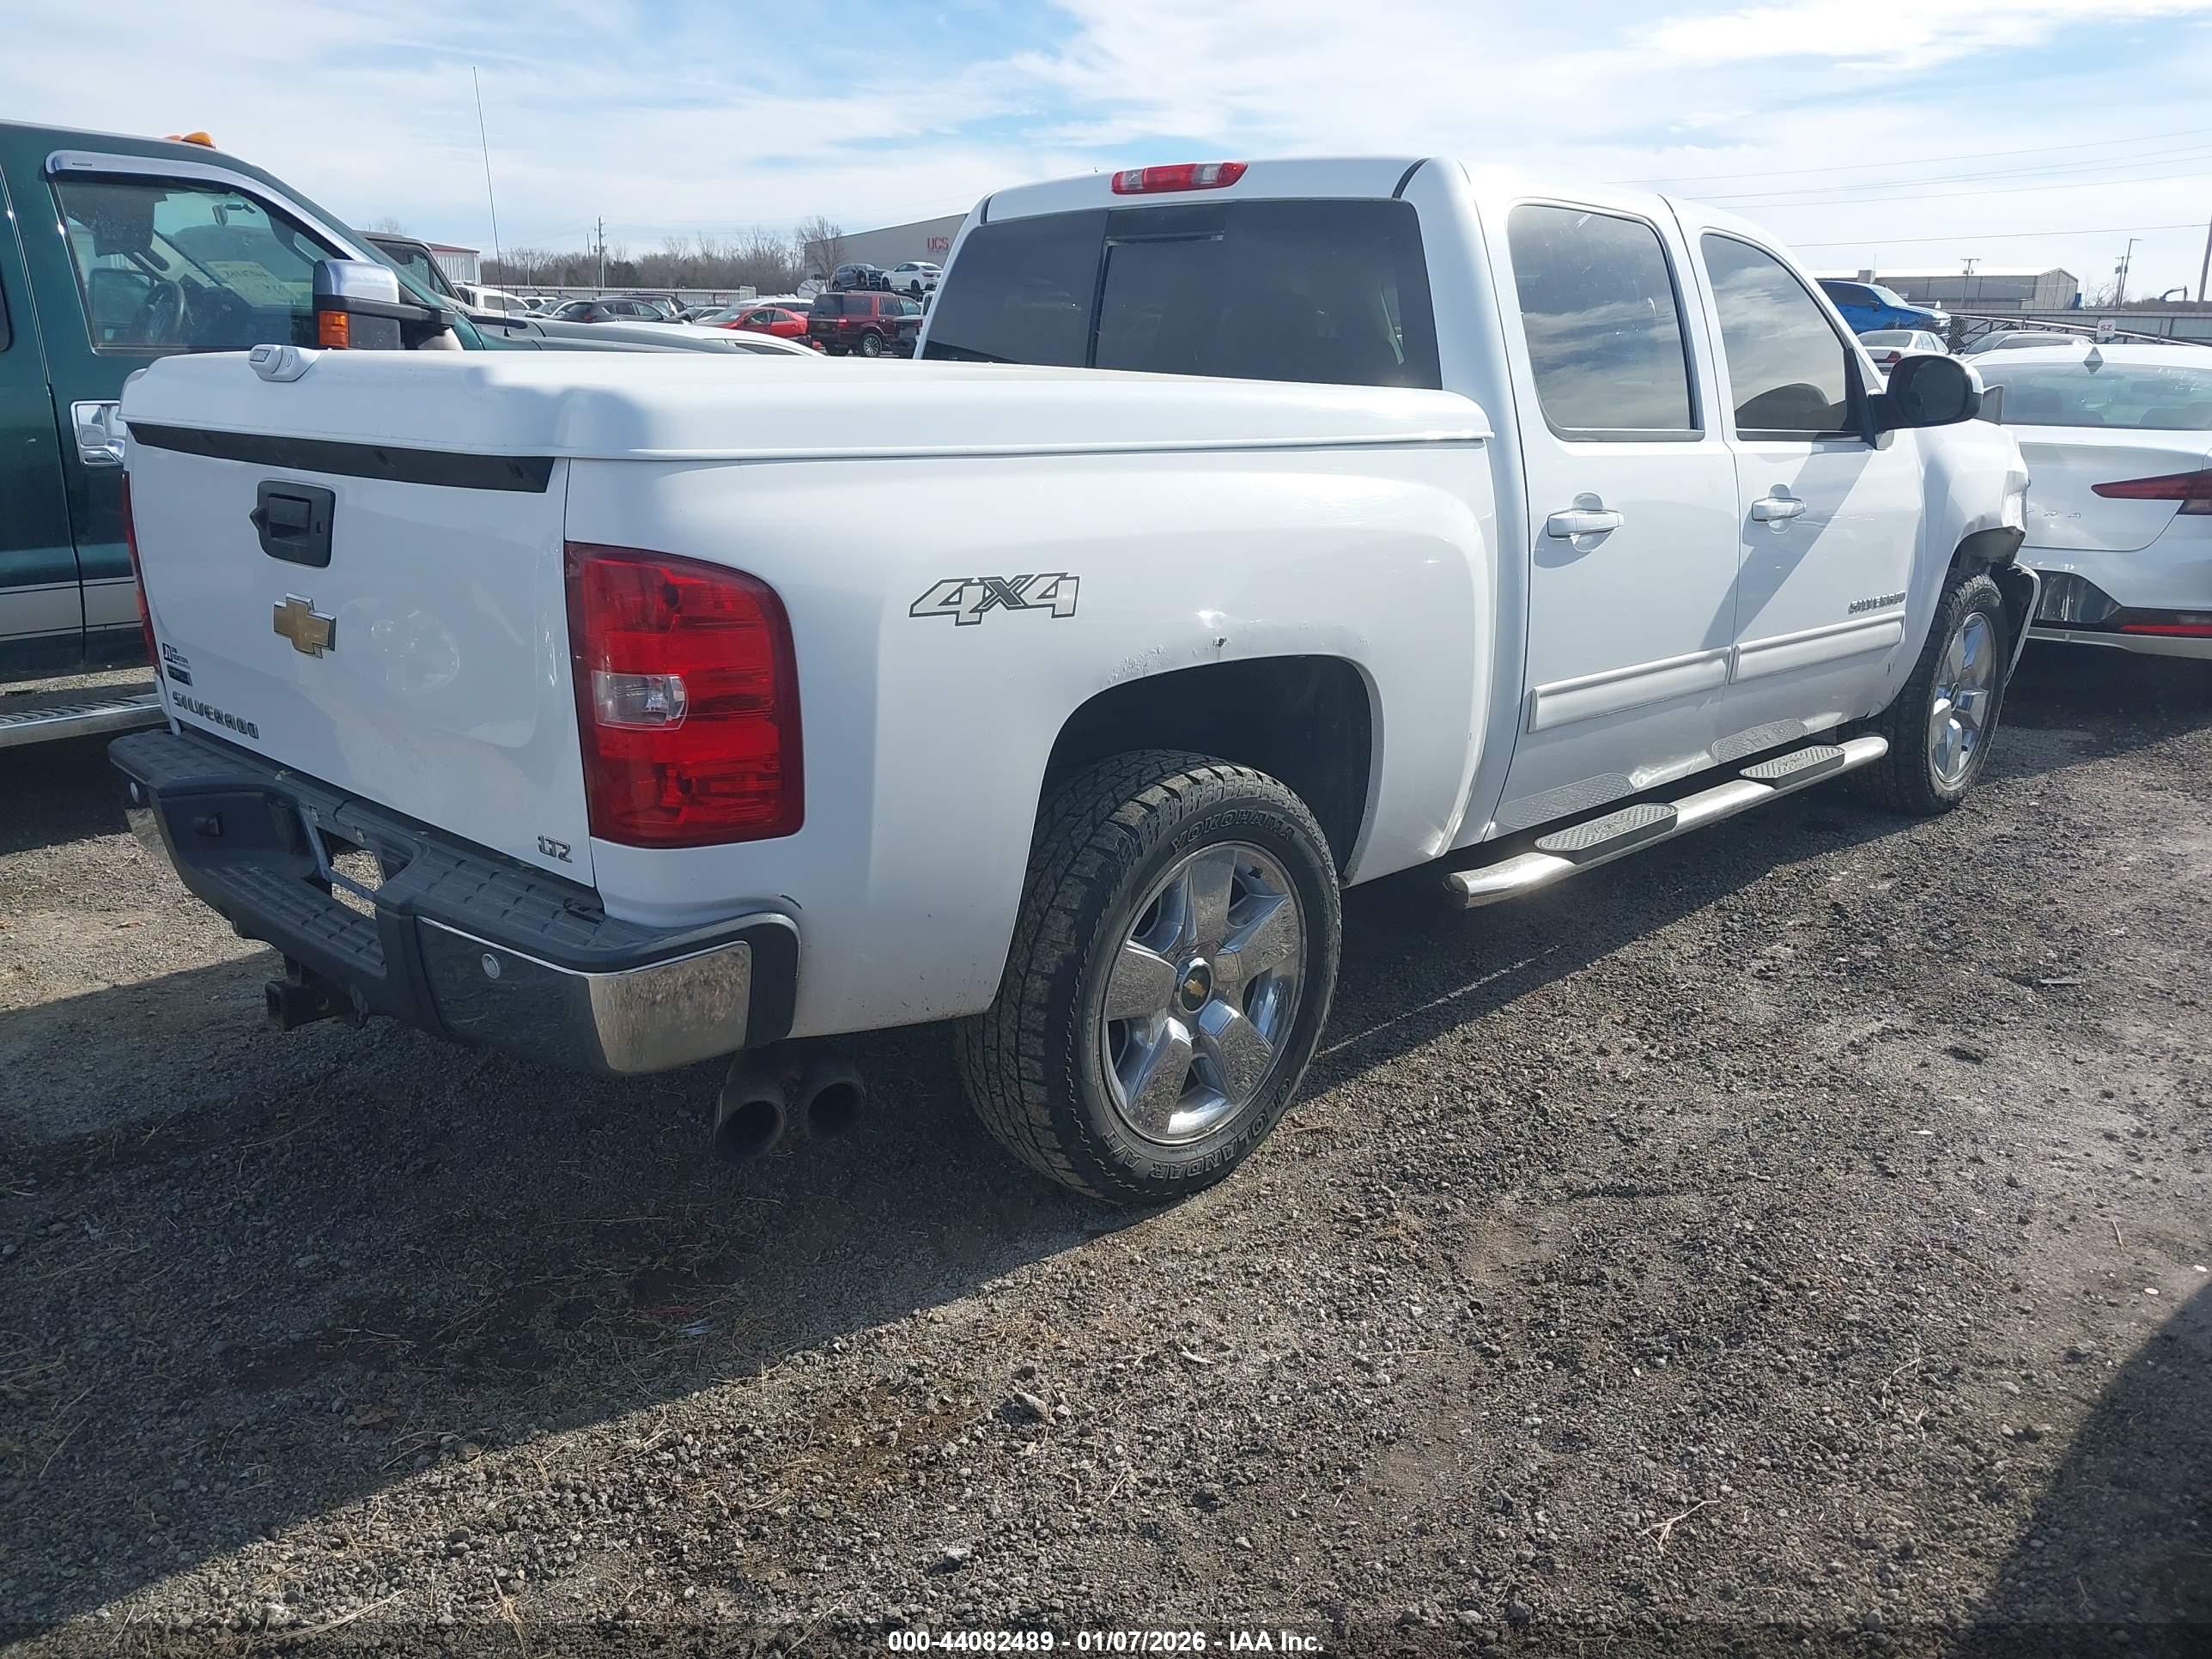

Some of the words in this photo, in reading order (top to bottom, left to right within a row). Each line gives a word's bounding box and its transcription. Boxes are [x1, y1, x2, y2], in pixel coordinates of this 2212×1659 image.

[927, 237, 949, 250] UCS
[172, 690, 260, 739] SILVERADO
[538, 835, 573, 864] LTZ
[1170, 809, 1296, 853] YOKOHAMA
[1102, 1131, 1142, 1170] A/T
